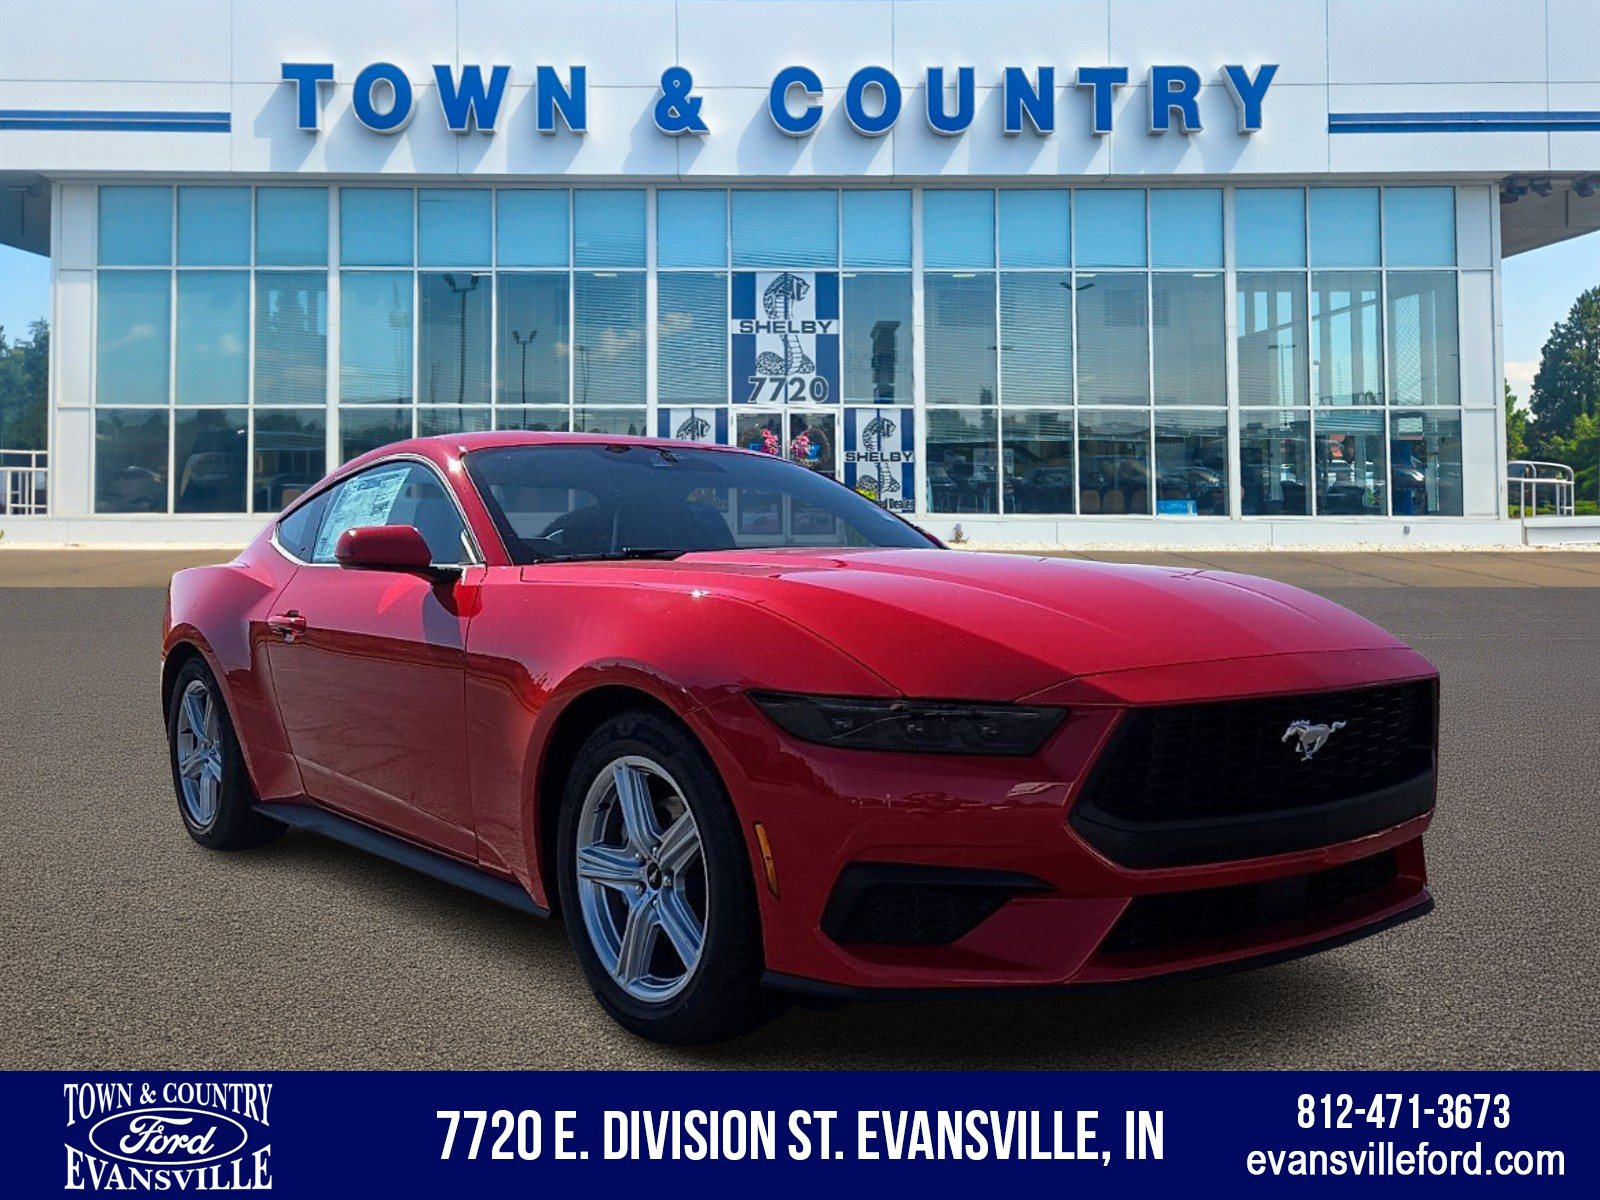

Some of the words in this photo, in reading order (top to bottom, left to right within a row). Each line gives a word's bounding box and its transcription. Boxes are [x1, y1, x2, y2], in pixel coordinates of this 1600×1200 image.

[281, 63, 589, 135] TOWN
[653, 66, 711, 136] &
[767, 64, 1280, 138] COUNTRY
[739, 320, 833, 335] SHELBY
[748, 376, 829, 403] 7720
[845, 451, 914, 463] SHELBY
[889, 497, 915, 510] Dealer
